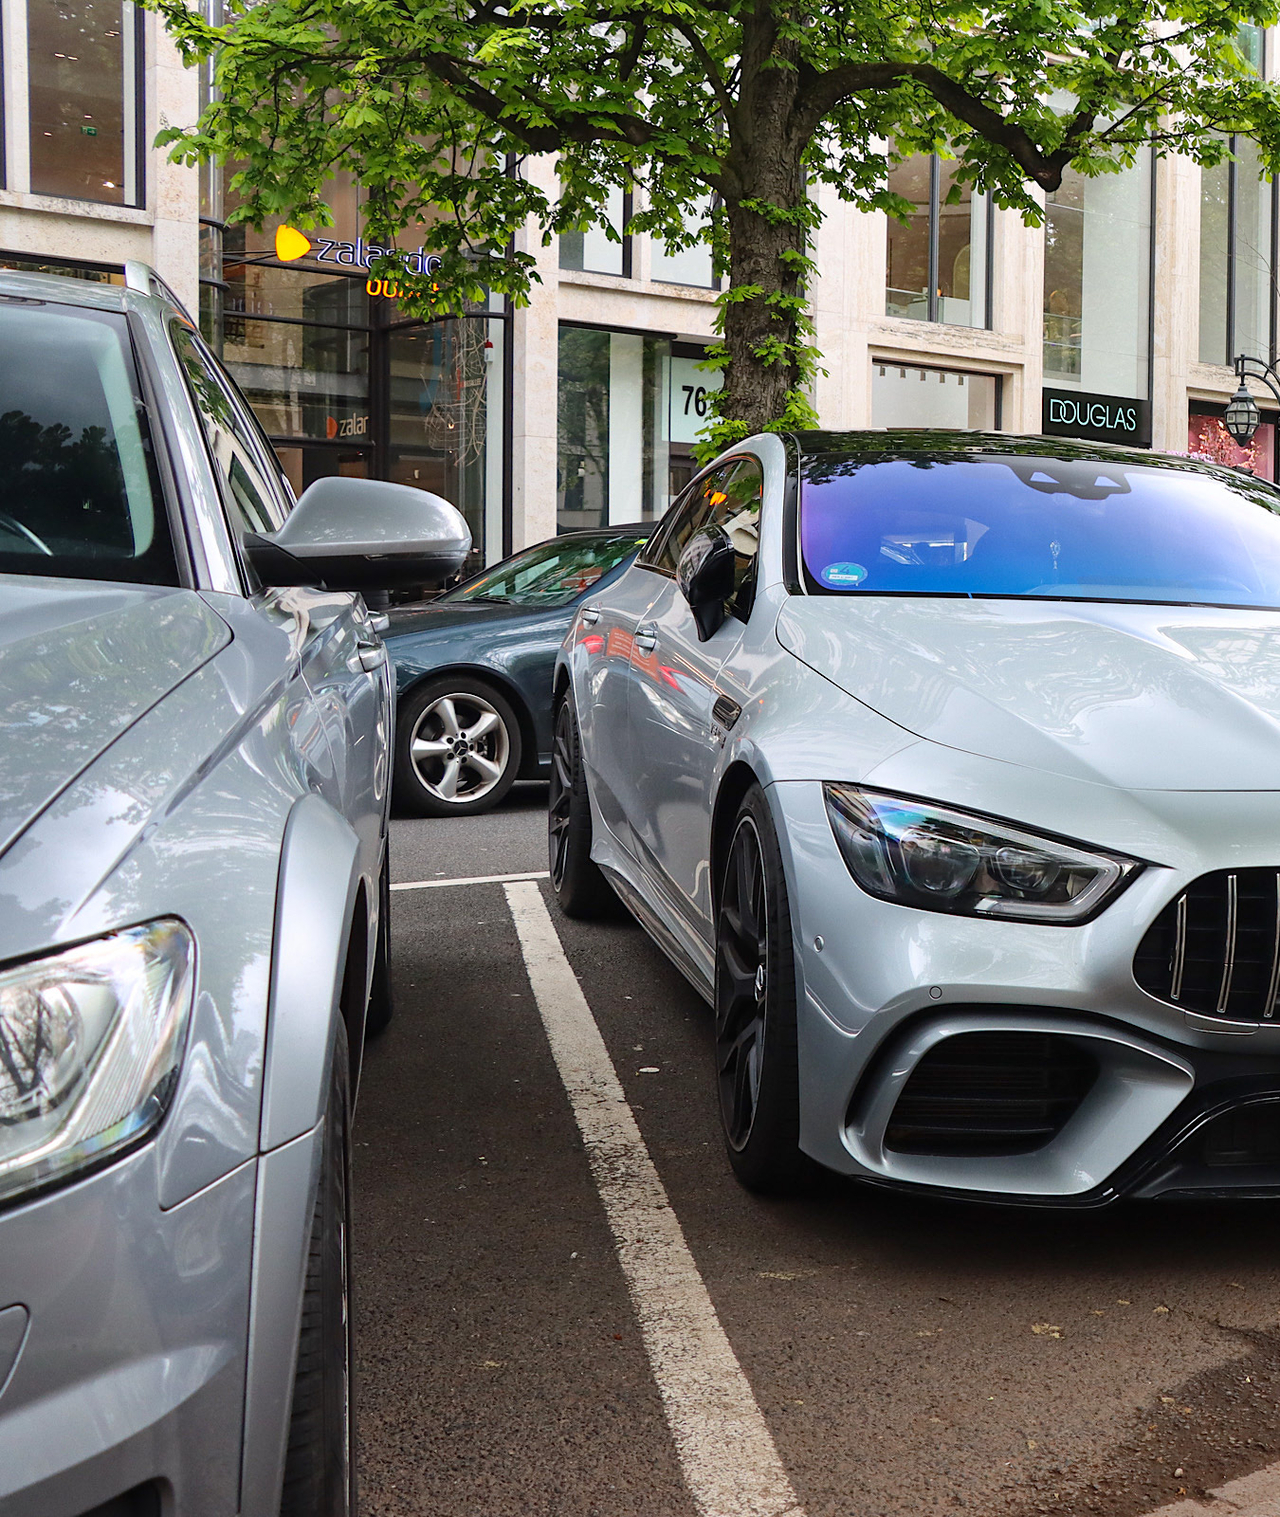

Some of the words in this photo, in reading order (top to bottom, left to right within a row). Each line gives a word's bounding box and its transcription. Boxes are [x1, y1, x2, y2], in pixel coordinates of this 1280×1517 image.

[316, 237, 443, 277] zalado
[681, 385, 707, 417] 76
[1049, 398, 1137, 432] DOUGLAS
